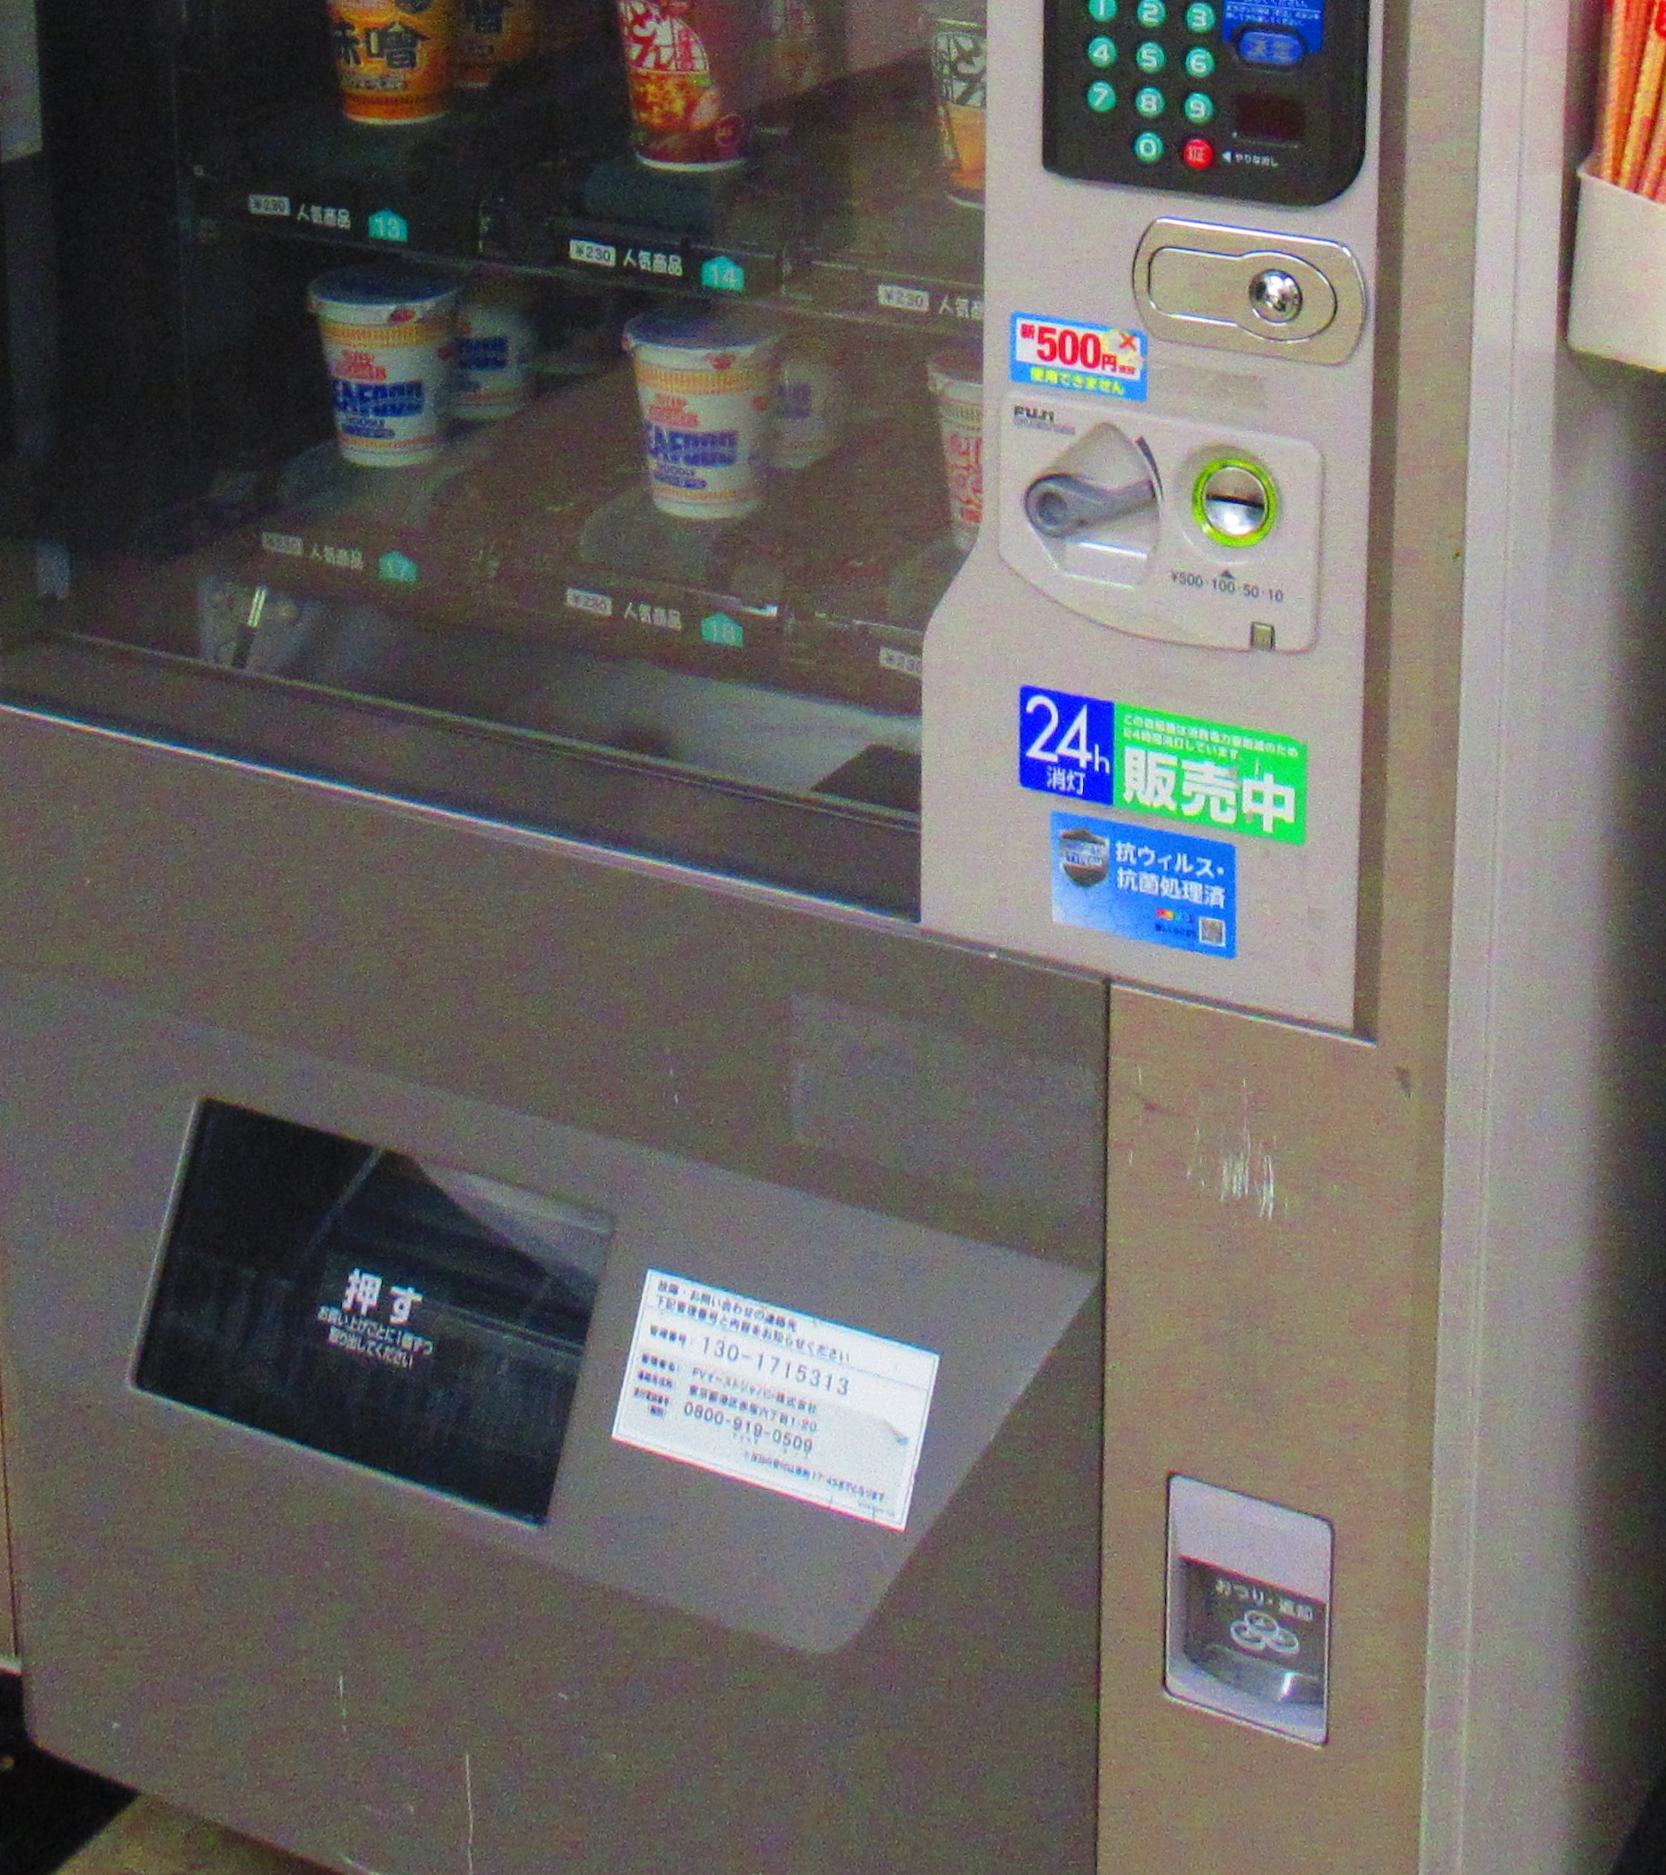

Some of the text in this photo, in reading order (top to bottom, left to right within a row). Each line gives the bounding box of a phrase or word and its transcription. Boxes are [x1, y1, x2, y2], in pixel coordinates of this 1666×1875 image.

[1143, 4, 1159, 23] 2
[1193, 9, 1207, 27] 3
[1093, 44, 1109, 62] 4
[1142, 49, 1158, 68] 5
[1192, 55, 1207, 73] 6
[1093, 88, 1108, 107] 7
[1142, 94, 1158, 112] 8
[1192, 100, 1207, 118] 9
[1140, 140, 1155, 156] 0
[574, 243, 612, 263] ¥230
[623, 247, 683, 277] 人気商品
[709, 264, 739, 286] 14
[1036, 326, 1118, 372] 500 円
[1029, 366, 1126, 396] 使用できません
[1025, 695, 1111, 774] 24h
[1046, 765, 1087, 796] 消灯
[1123, 745, 1296, 835] 販売中
[1115, 841, 1225, 879] 抗ウィルス・
[1116, 867, 1226, 910] 抗菌処理済
[342, 1267, 425, 1325] 押す
[703, 1336, 850, 1397] 130-1715313
